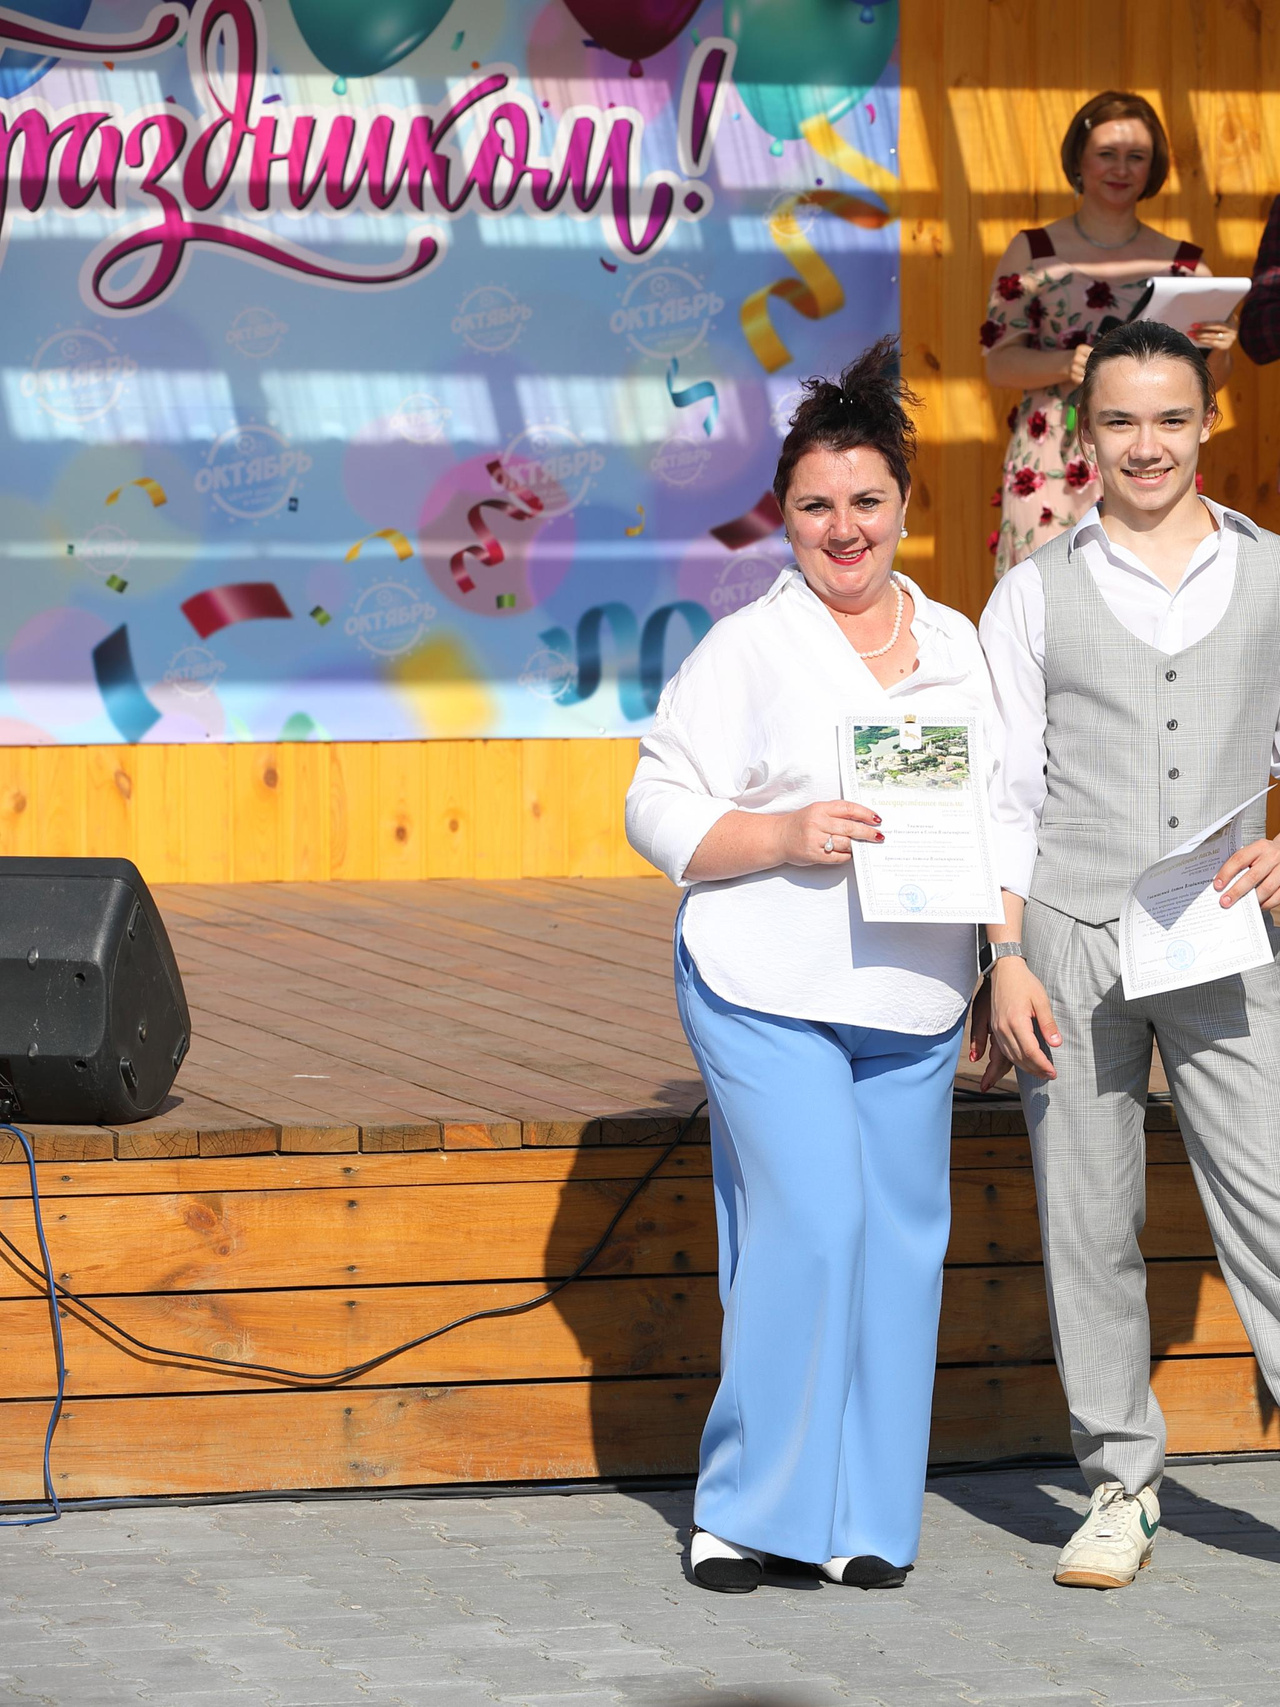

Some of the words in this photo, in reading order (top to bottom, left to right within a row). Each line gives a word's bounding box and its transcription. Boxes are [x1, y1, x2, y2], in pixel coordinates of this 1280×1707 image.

[451, 303, 533, 335] ОКТЯБРЬ
[609, 291, 725, 334] ОКТЯБРЬ
[19, 354, 139, 398] ОКТЯБРЬ
[194, 451, 313, 493] ОКТЯБРЬ
[489, 450, 606, 492] ОКТЯБРЬ
[343, 600, 438, 636] ОКТЯБРЬ
[162, 659, 228, 684] ОКТЯБРЬ
